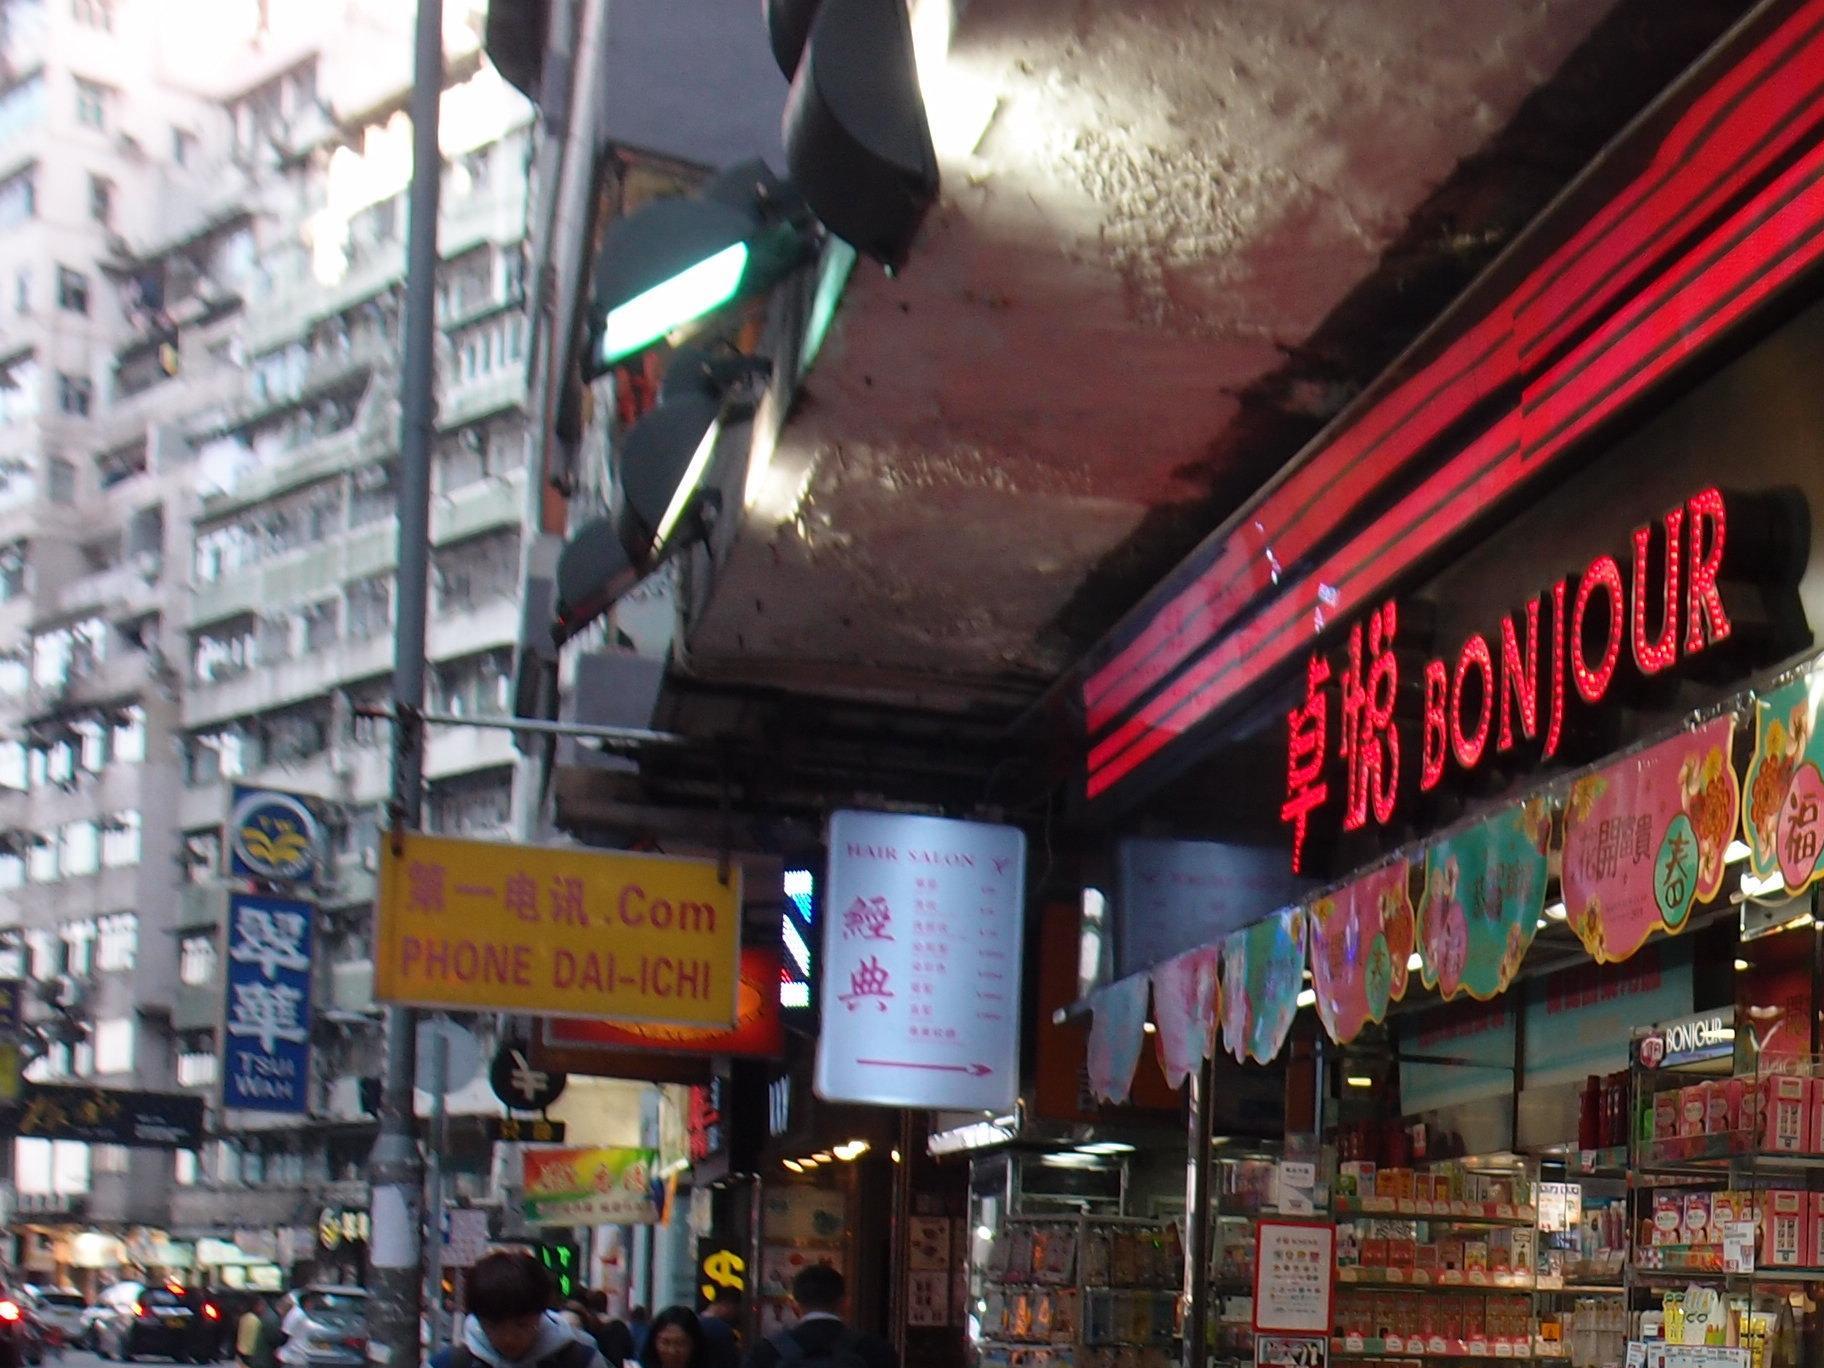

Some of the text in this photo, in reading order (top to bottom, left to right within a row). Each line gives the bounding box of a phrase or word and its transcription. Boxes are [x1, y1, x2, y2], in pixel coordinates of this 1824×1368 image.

[1281, 486, 1731, 875] 卓悅 BONJOUR
[1785, 791, 1819, 865] 福
[229, 905, 311, 1056] 翠華
[400, 935, 711, 1000] PHONE DAI-ICHI
[237, 1051, 296, 1077] TSUI
[1665, 1017, 1723, 1054] BONJOUR
[234, 1074, 294, 1099] WAH
